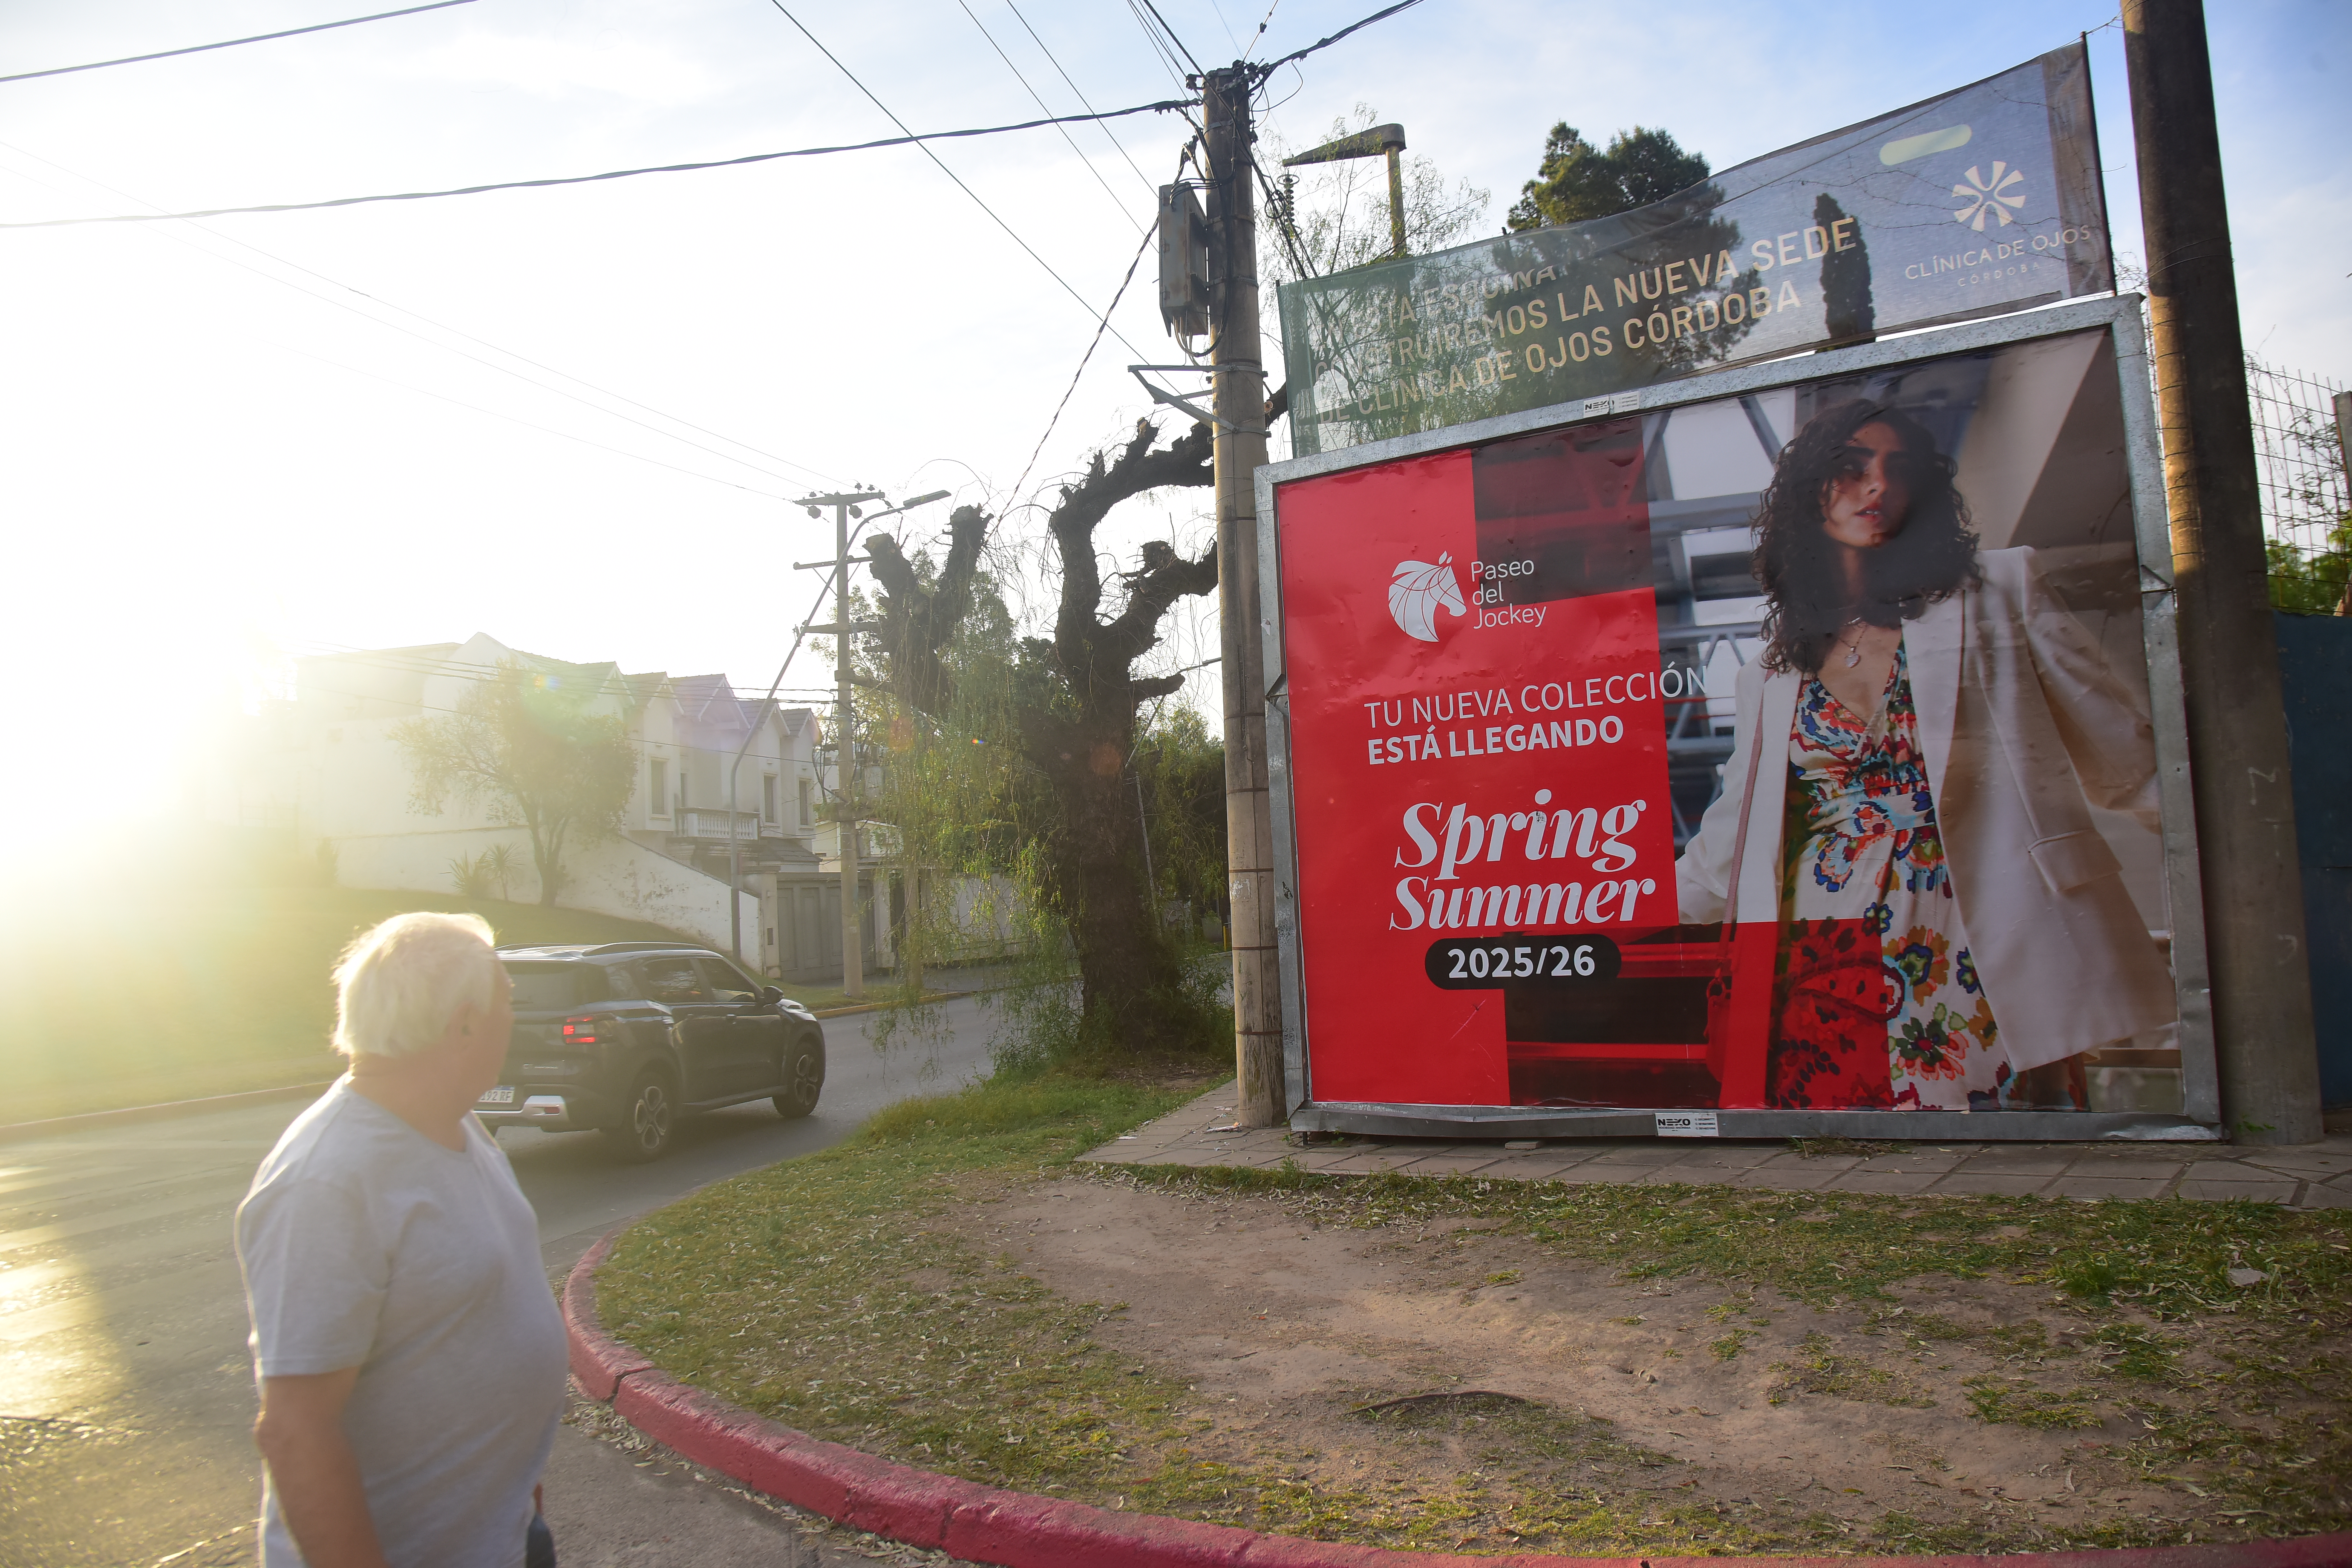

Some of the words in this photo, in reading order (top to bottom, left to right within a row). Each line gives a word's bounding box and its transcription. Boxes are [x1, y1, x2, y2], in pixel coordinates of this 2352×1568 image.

[1905, 248, 1993, 280] CLÍNICA
[1998, 239, 2026, 259] DE
[2032, 225, 2091, 251] OJOS
[1957, 262, 2040, 287] CÓRDOBA
[1315, 298, 1548, 384] CONSTRUIREMOS
[1557, 285, 1605, 322] LA
[1614, 249, 1739, 308] NUEVA
[1751, 217, 1856, 272] SEDE
[1352, 296, 1416, 337] ESTA
[1424, 265, 1557, 317] ESQUINA
[1320, 404, 1350, 424] DE
[1358, 363, 1467, 414] CLÍNICA
[1475, 350, 1517, 386] DE
[1525, 326, 1613, 373] OJOS
[1623, 280, 1801, 349] CÓRDOBA
[1470, 560, 1534, 582] Paseo
[1472, 581, 1504, 605] del
[1473, 603, 1547, 629] Jockey
[1364, 699, 1404, 729] TU
[1412, 688, 1514, 724] NUEVA
[1520, 661, 1708, 713] COLECCIÓN
[1368, 725, 1441, 765] ESTÁ
[1449, 716, 1624, 758] LLEGANDO
[1394, 789, 1646, 880] Spring
[1389, 876, 1656, 931] Summer
[1448, 945, 1595, 978] 2025/26
